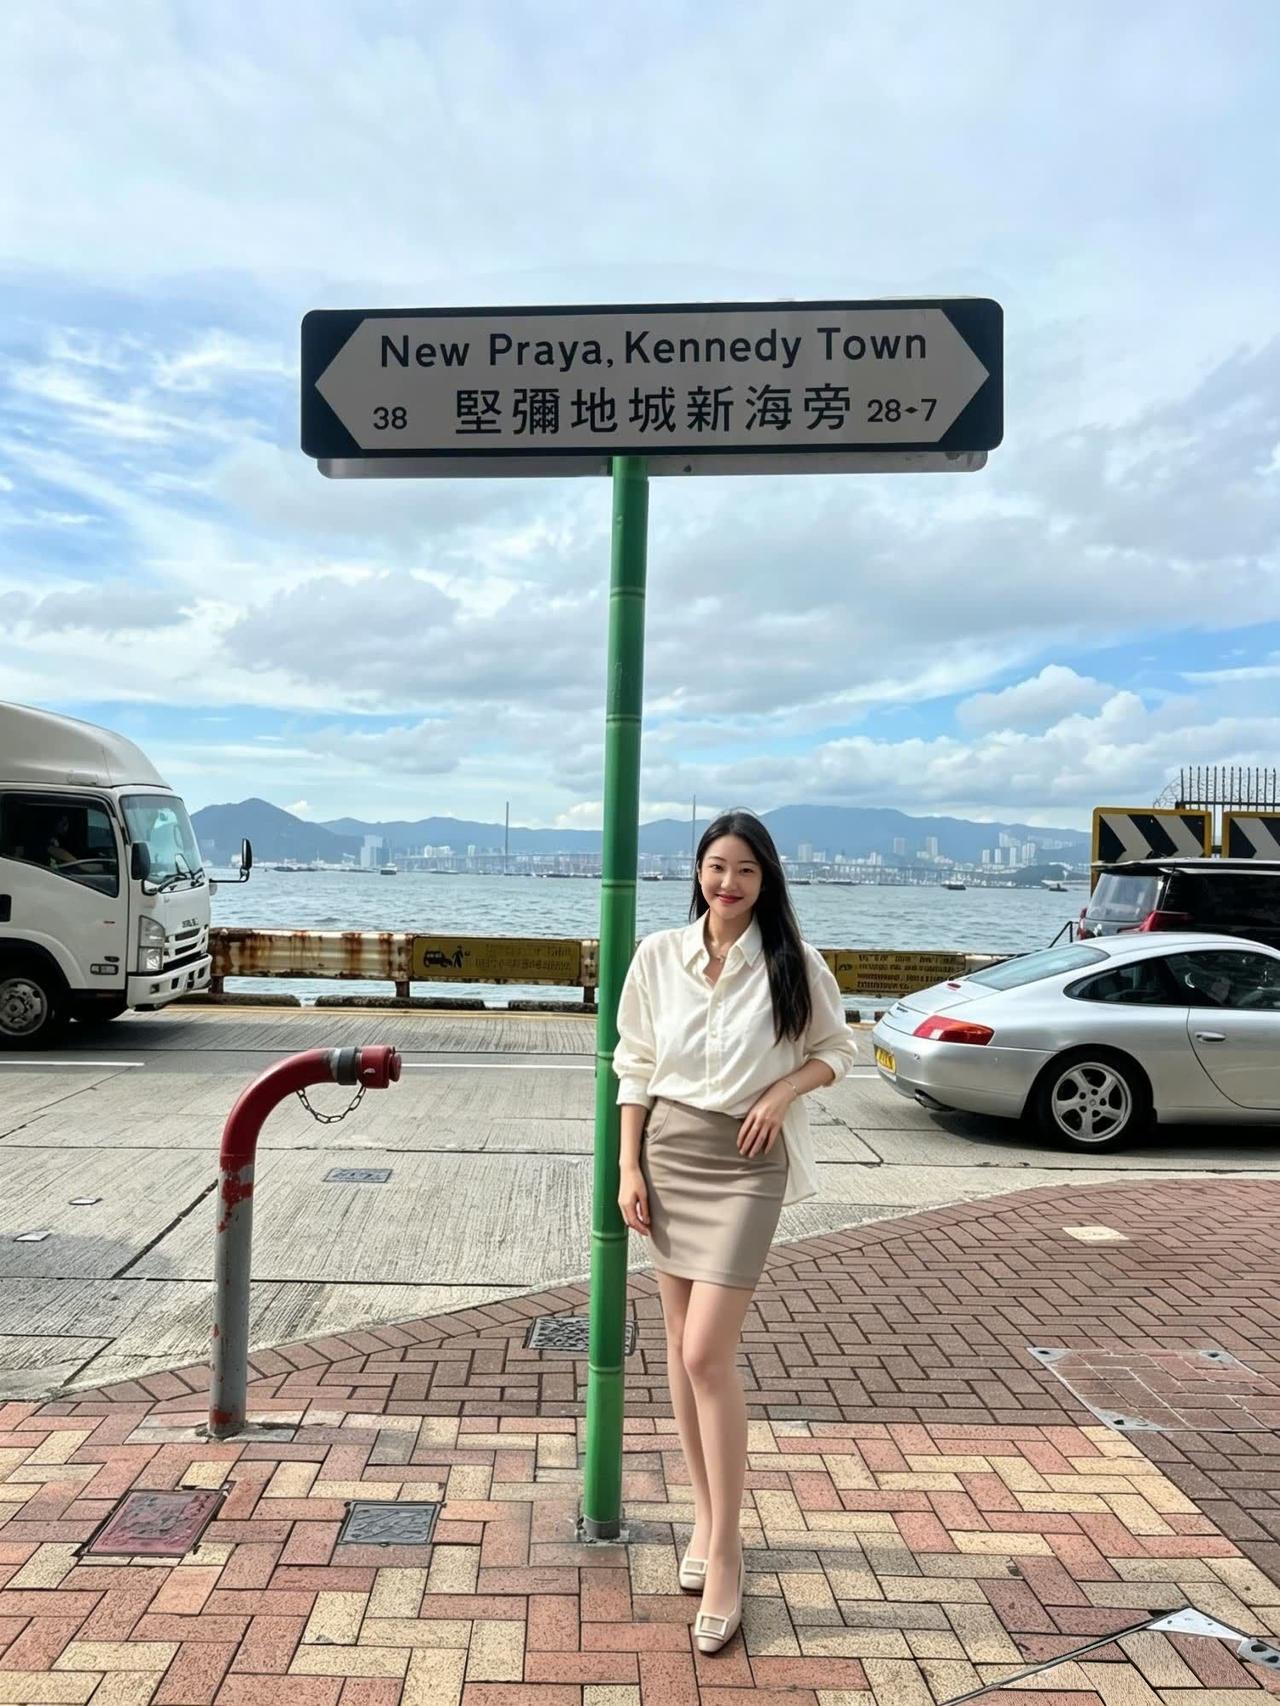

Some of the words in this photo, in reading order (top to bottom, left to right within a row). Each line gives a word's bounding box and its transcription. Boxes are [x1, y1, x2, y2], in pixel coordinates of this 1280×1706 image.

[381, 334, 470, 368] New
[489, 333, 614, 373] Praya,
[625, 328, 803, 369] Kennedy
[816, 327, 926, 361] Town
[372, 406, 408, 431] 38
[455, 382, 851, 436] 堅彌地城新海旁
